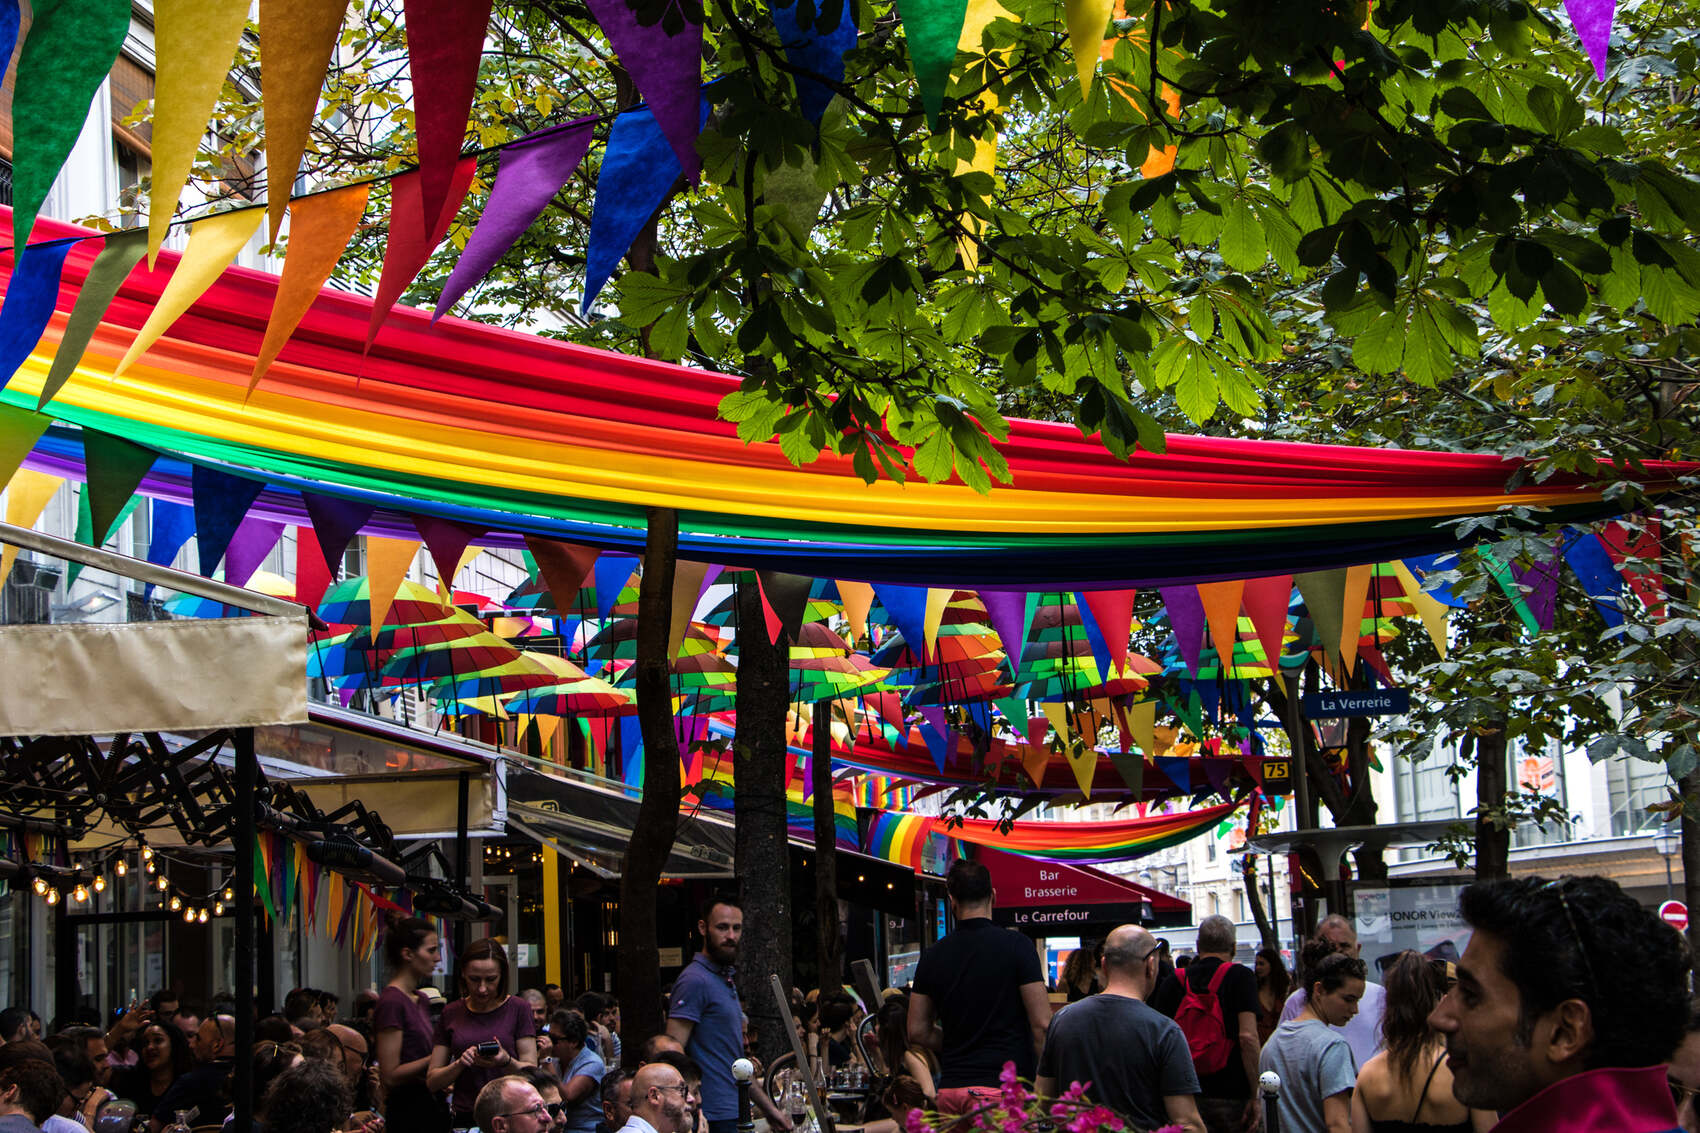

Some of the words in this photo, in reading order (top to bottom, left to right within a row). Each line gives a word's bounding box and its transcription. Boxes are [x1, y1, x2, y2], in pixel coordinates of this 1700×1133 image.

[1321, 699, 1336, 711] La
[1338, 697, 1392, 709] Verrerie
[1269, 763, 1286, 777] 75
[1039, 869, 1060, 881] Bar
[1024, 884, 1078, 898] Brasserie
[1015, 912, 1029, 923] Le
[1031, 909, 1090, 922] Carrefour
[1383, 910, 1427, 921] HONOR
